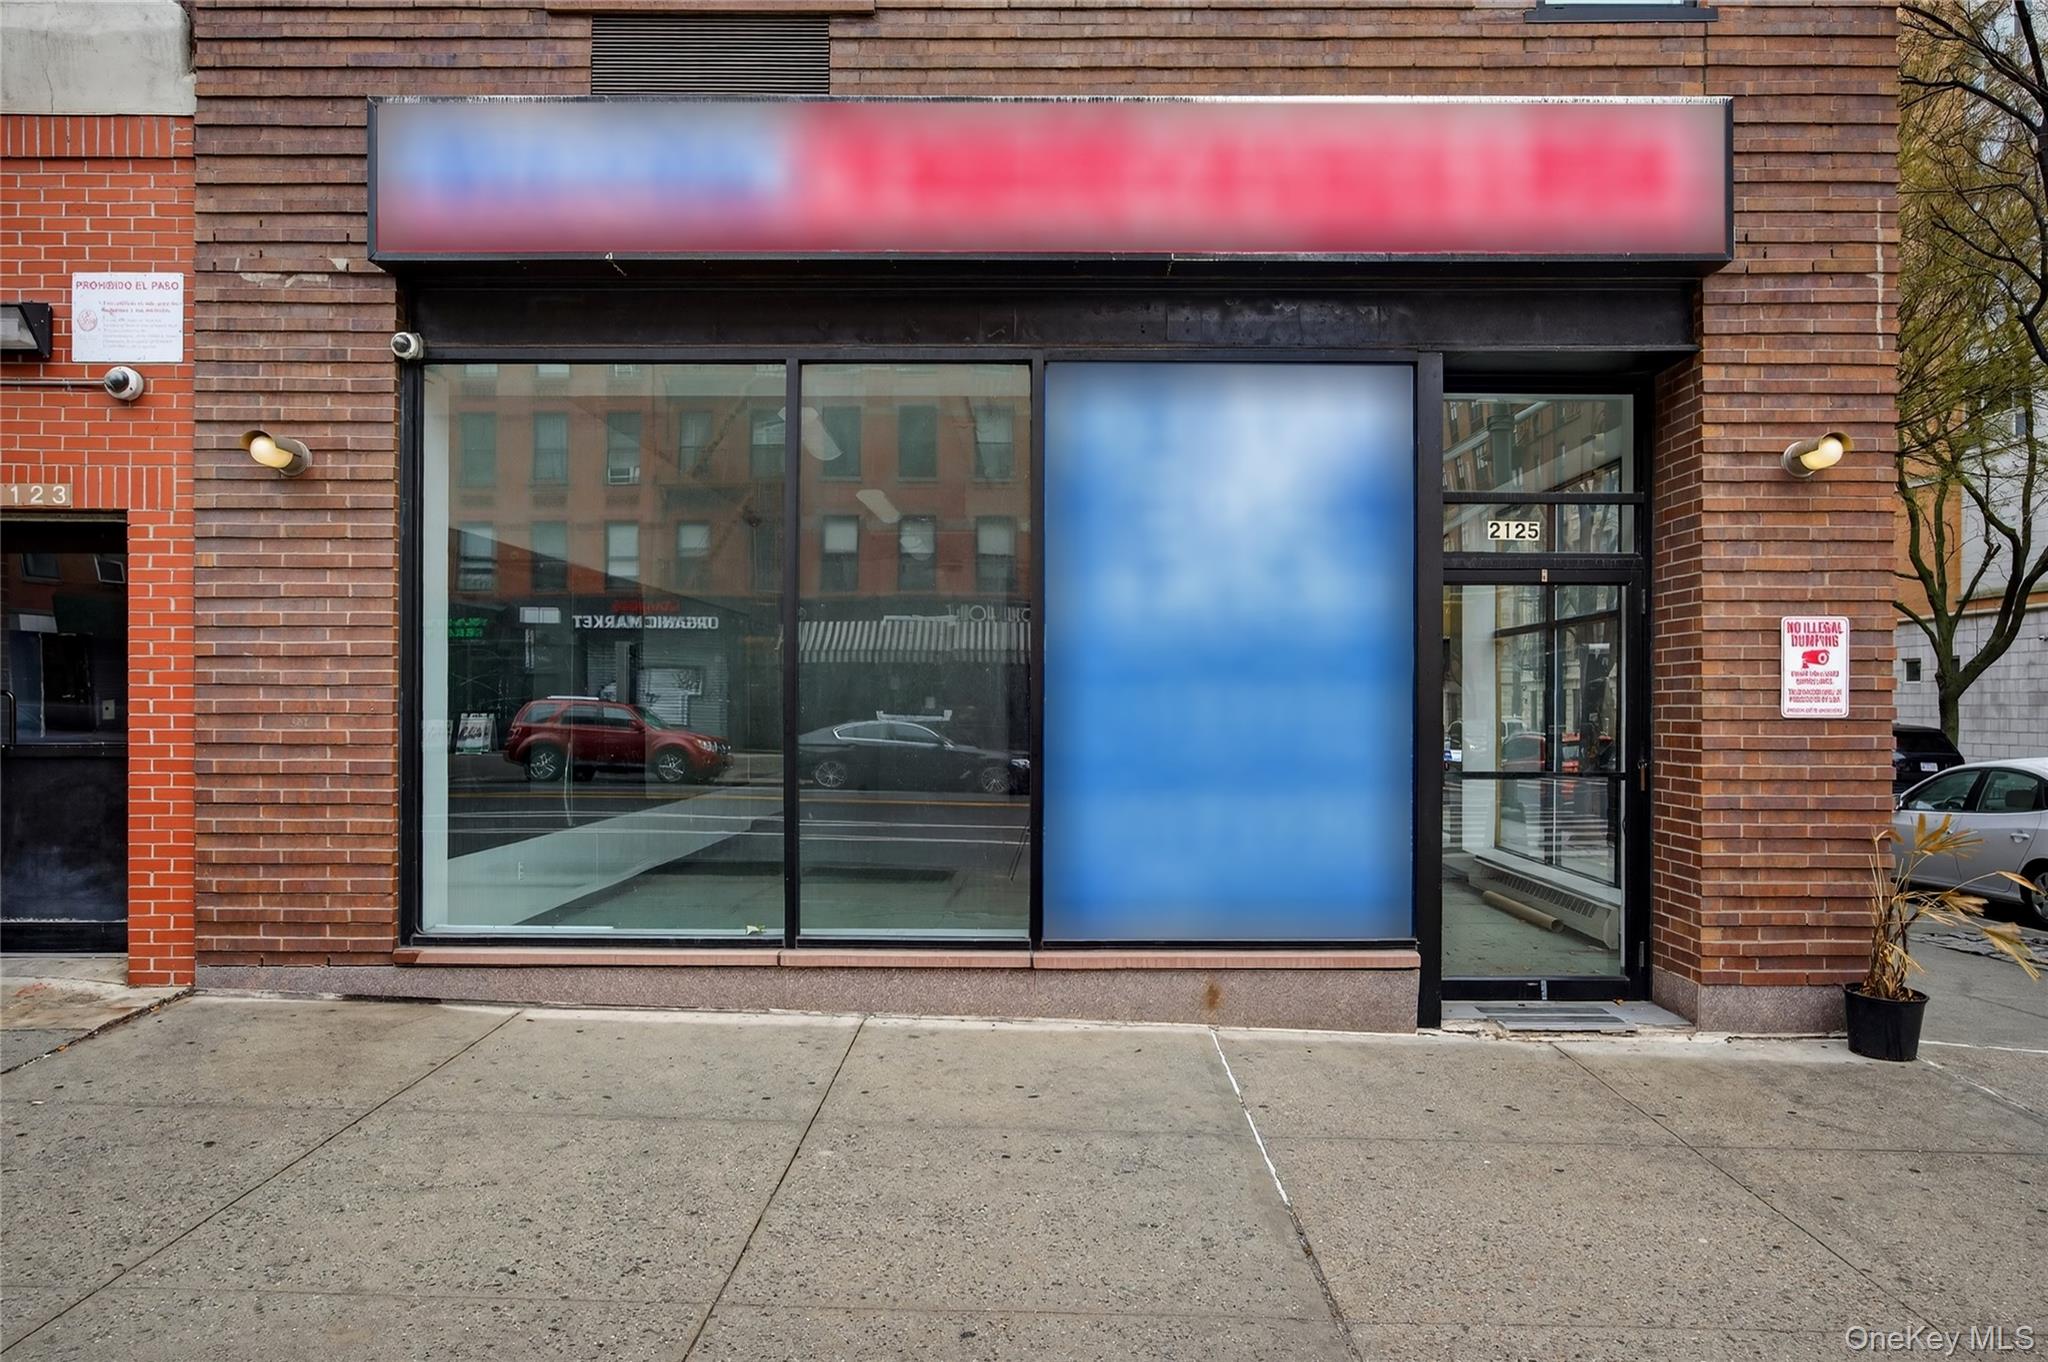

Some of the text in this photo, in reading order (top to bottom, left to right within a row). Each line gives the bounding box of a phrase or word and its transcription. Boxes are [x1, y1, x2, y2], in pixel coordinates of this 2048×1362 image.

[135, 280, 148, 290] EL
[151, 280, 179, 290] PASO
[1489, 522, 1539, 539] 2125
[1787, 621, 1844, 634] NO ILLEGAL
[1791, 635, 1840, 647] DUMPING
